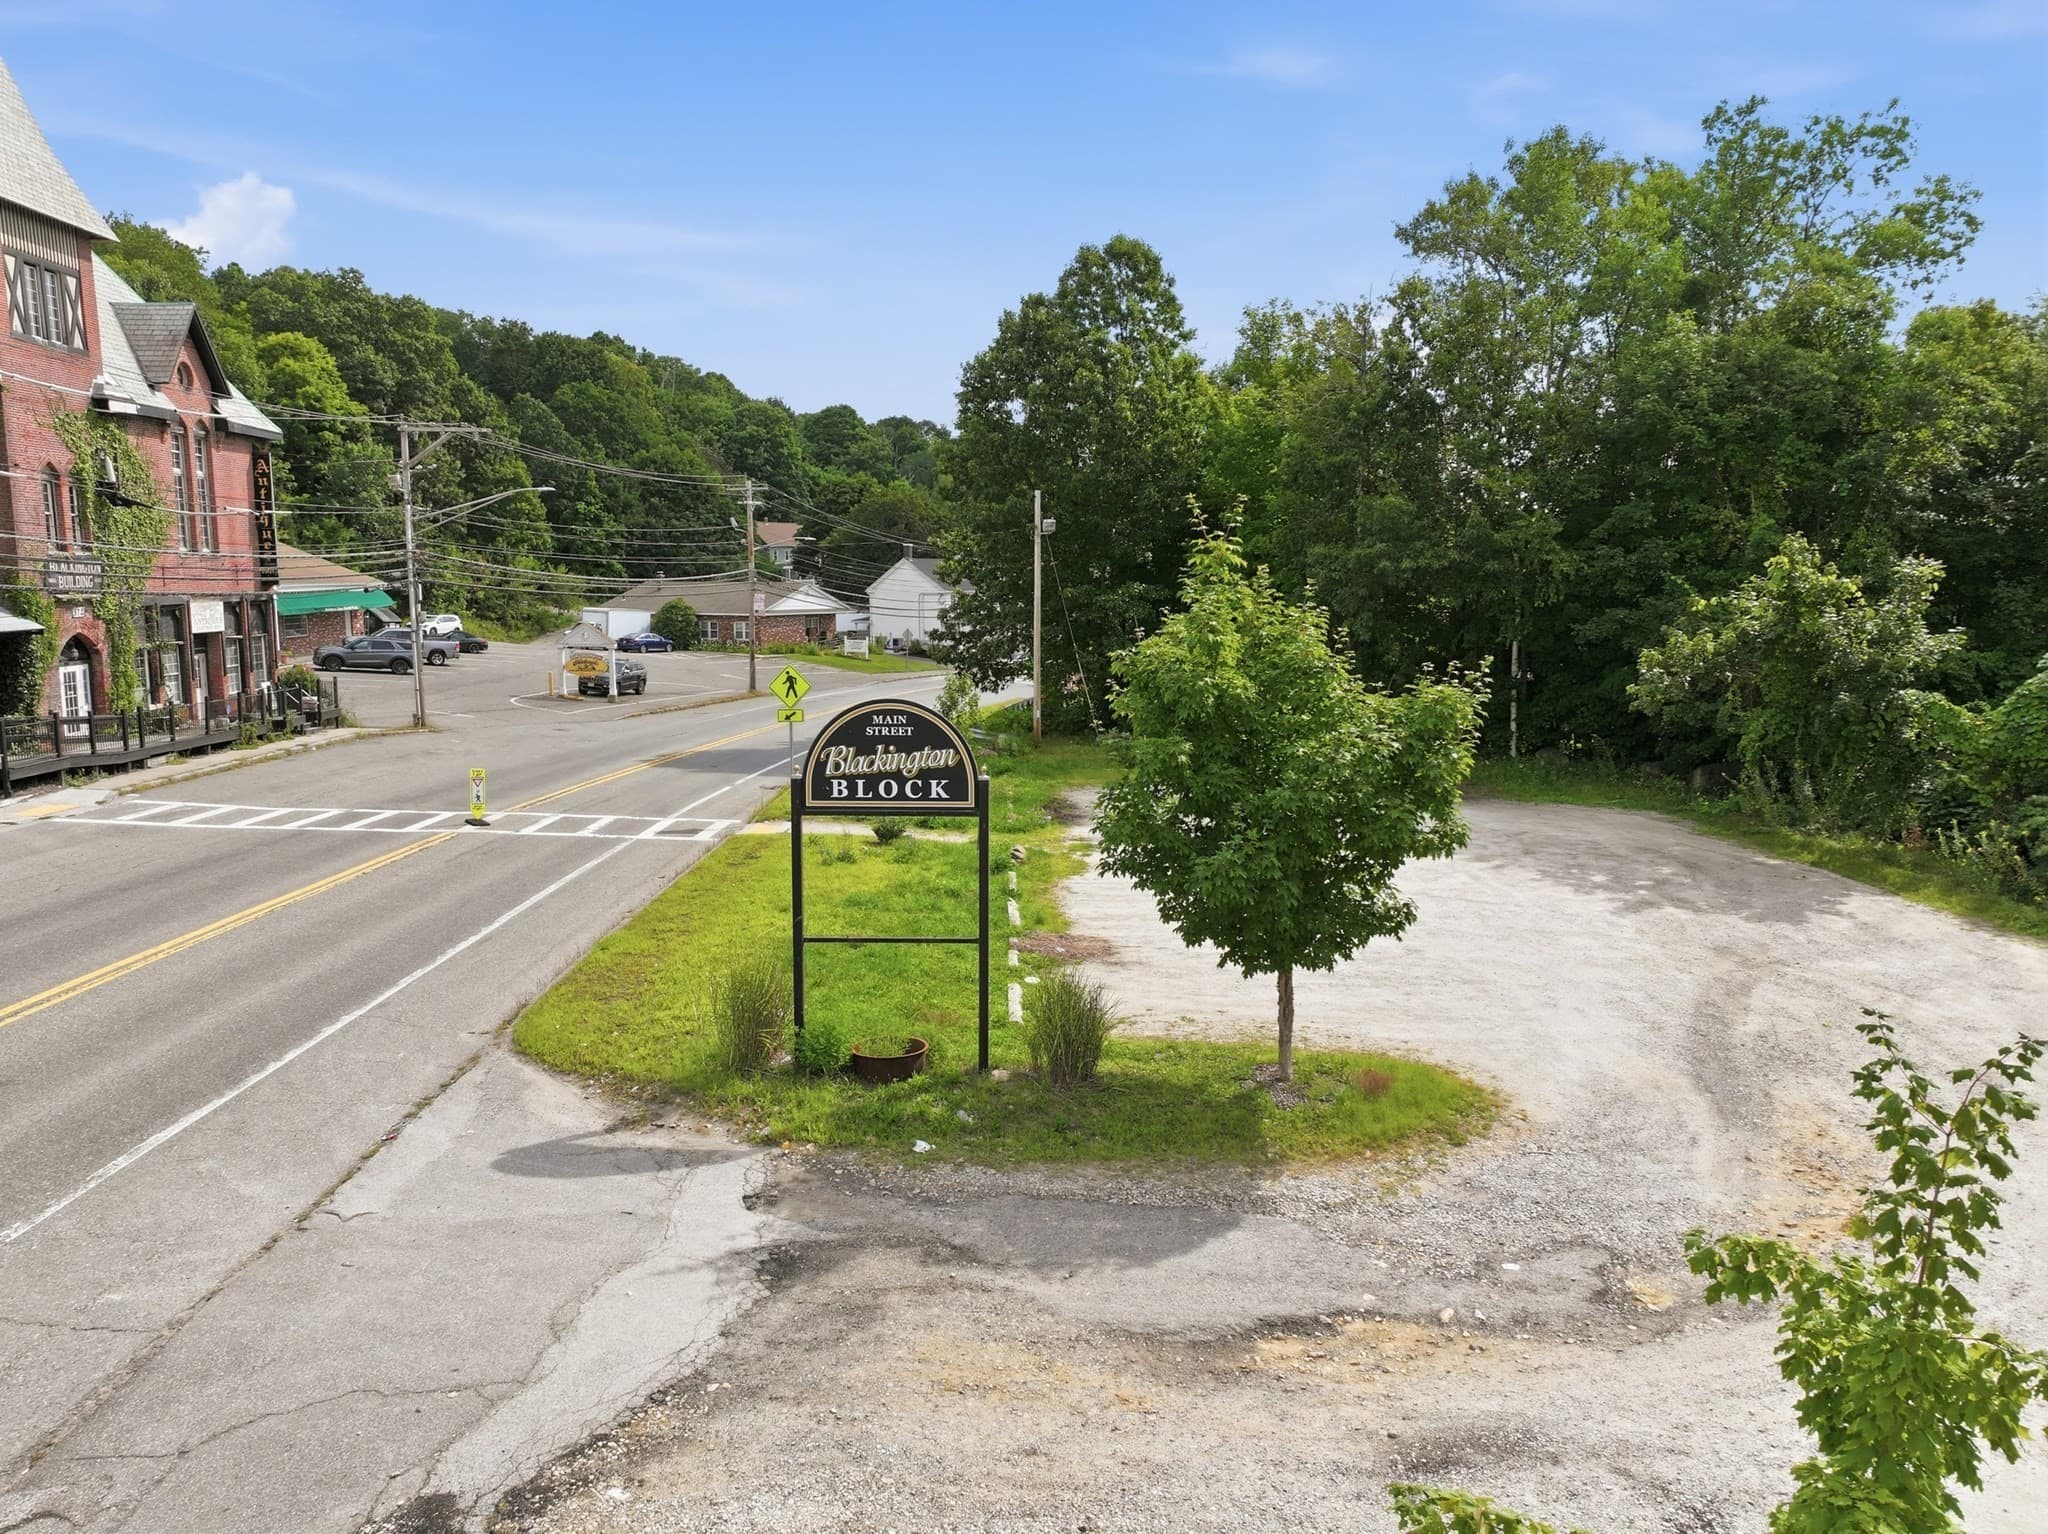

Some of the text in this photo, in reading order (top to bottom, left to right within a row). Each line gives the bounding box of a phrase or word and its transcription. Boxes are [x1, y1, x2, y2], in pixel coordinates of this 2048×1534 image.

[58, 575, 94, 588] BUILDING
[872, 715, 907, 724] MAIN
[865, 726, 914, 736] STREET
[820, 744, 960, 778] Blackington
[830, 779, 950, 799] BLOCK
